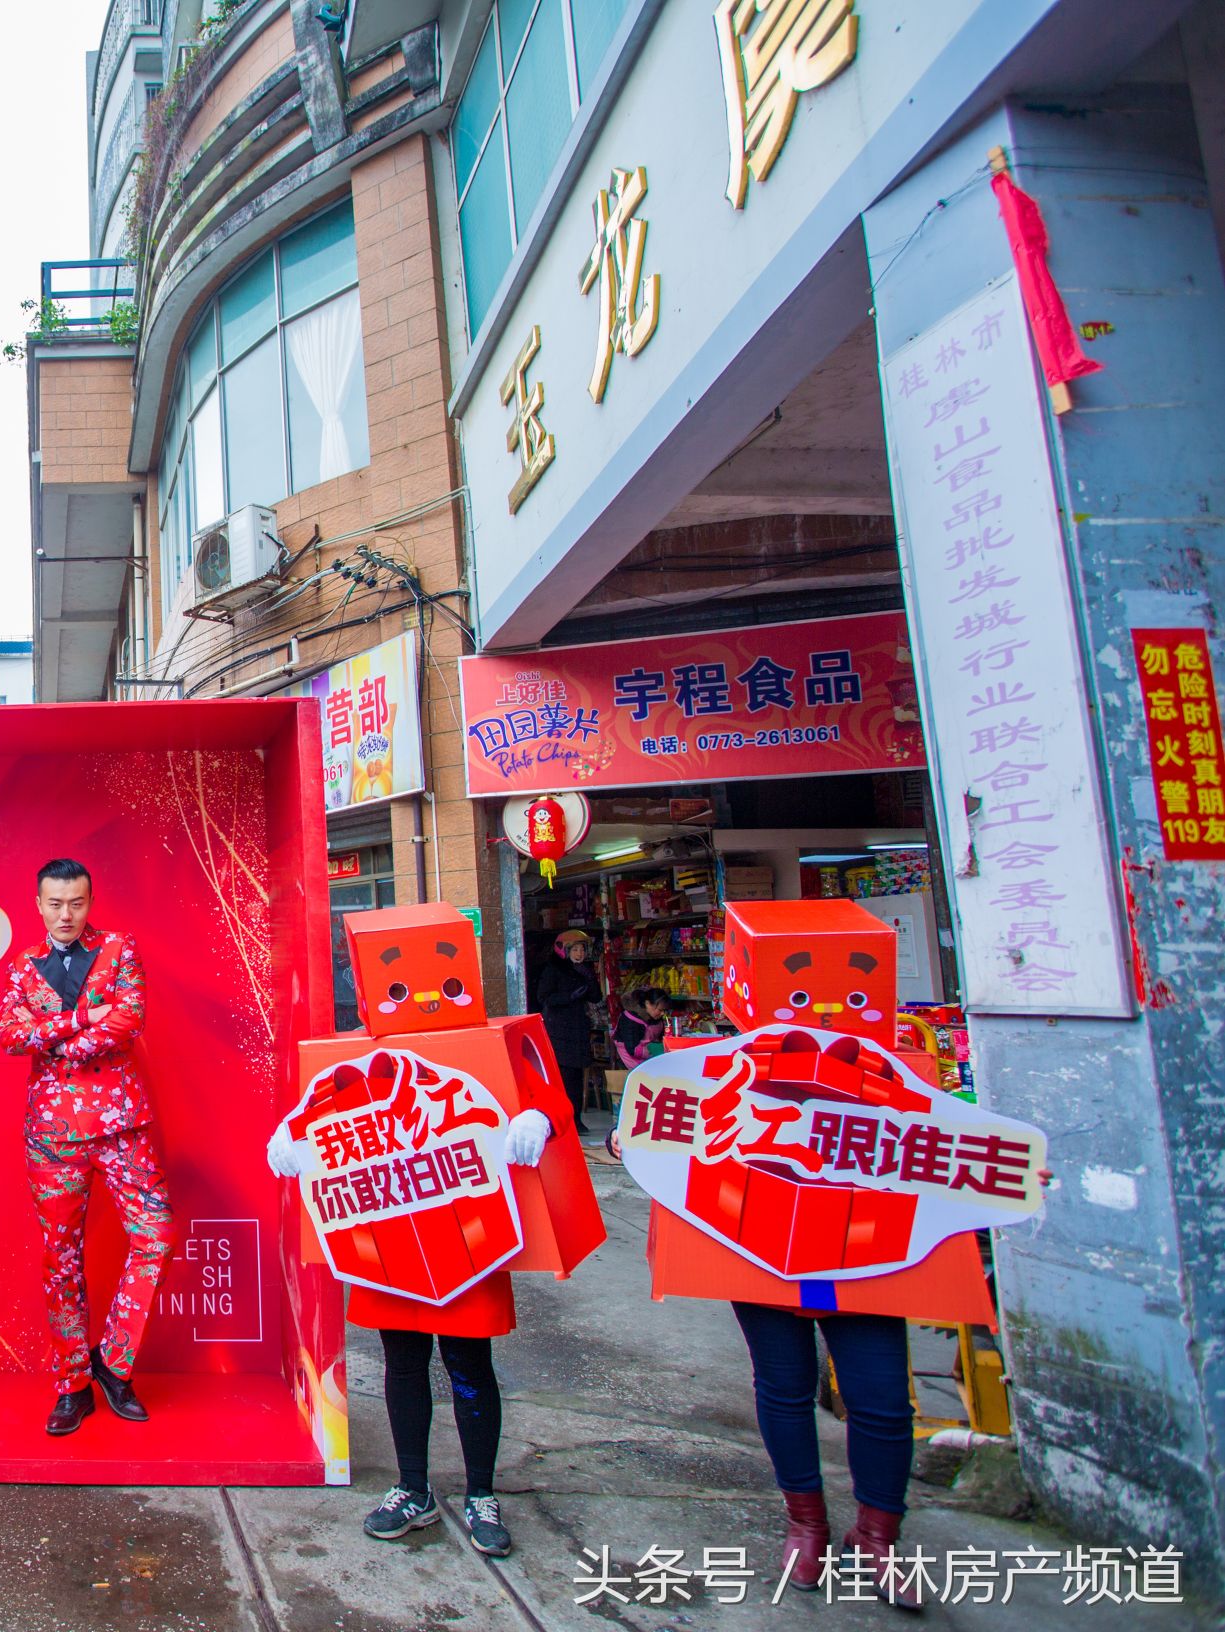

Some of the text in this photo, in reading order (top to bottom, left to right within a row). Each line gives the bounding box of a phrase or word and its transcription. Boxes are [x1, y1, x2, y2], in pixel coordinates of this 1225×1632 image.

[898, 310, 1006, 399] 桂林市
[322, 674, 390, 750] 营部
[495, 681, 567, 707] 上好佳
[514, 671, 541, 682] Oishi
[613, 648, 863, 723] 宇程食品
[468, 702, 601, 758] 田园薯片
[492, 742, 581, 778] Potato Chips
[1173, 642, 1225, 844] 危险时刻真朋友
[313, 1055, 500, 1171] 我敢红
[630, 1059, 1032, 1201] 谁红跟谁走
[311, 1138, 490, 1225] 你敢拍吗
[159, 1292, 233, 1316] INING
[202, 1265, 232, 1288] SH
